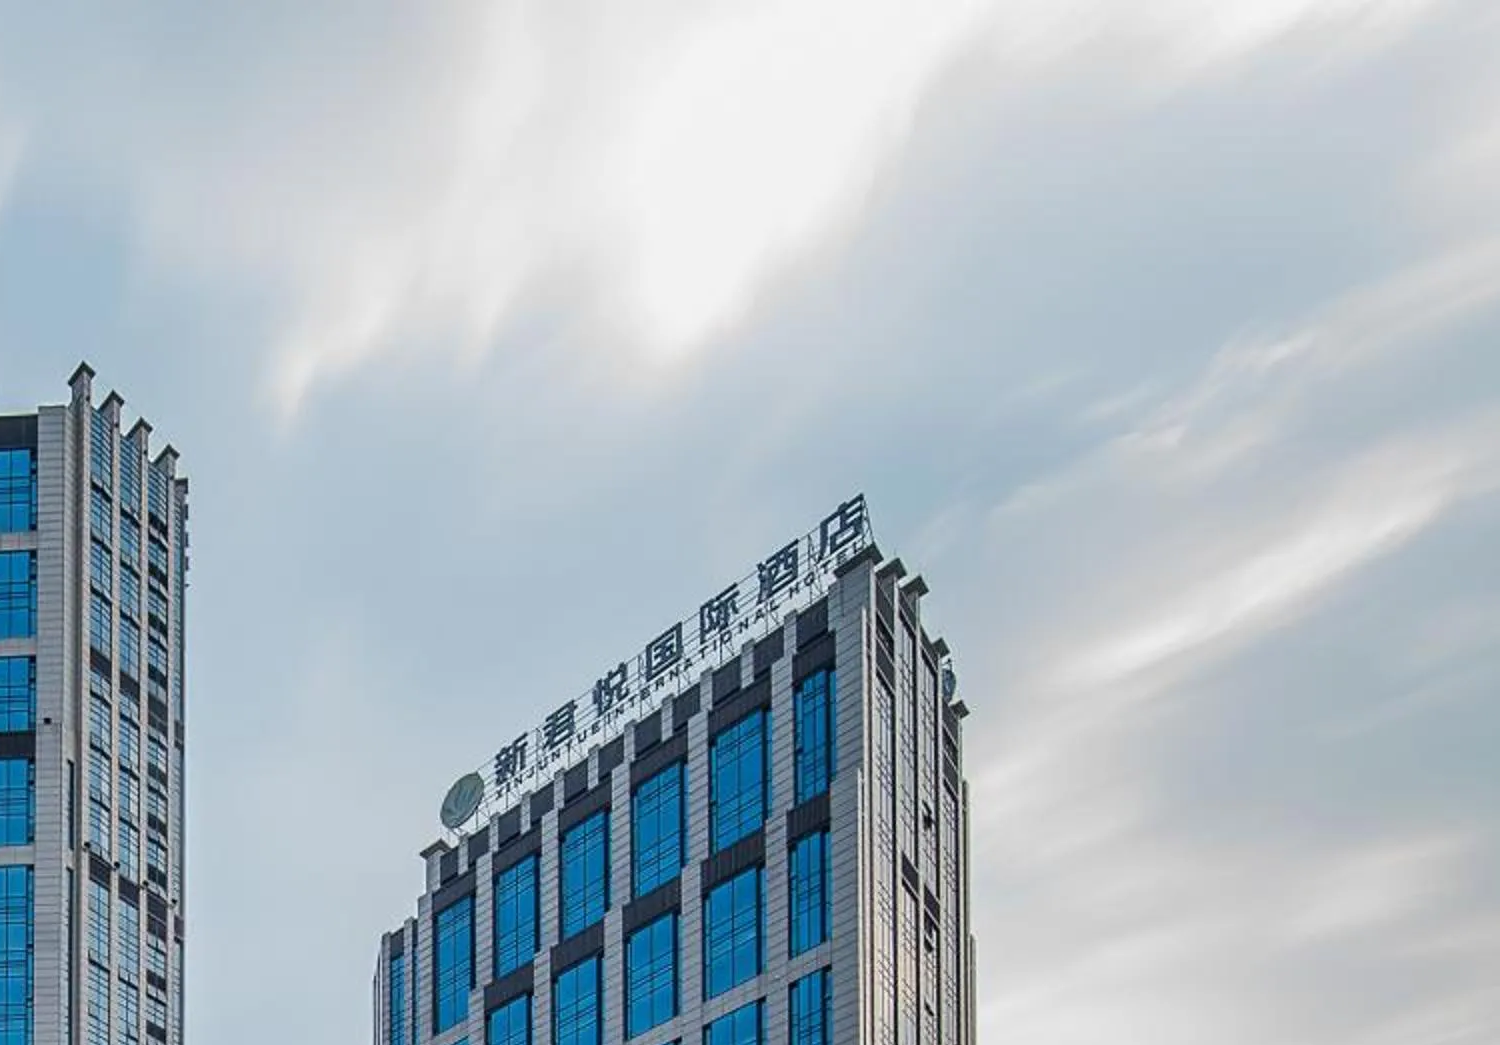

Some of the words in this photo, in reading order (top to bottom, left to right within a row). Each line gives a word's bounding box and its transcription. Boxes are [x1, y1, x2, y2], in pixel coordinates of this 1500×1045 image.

[494, 492, 864, 786] 新君悦国际酒店
